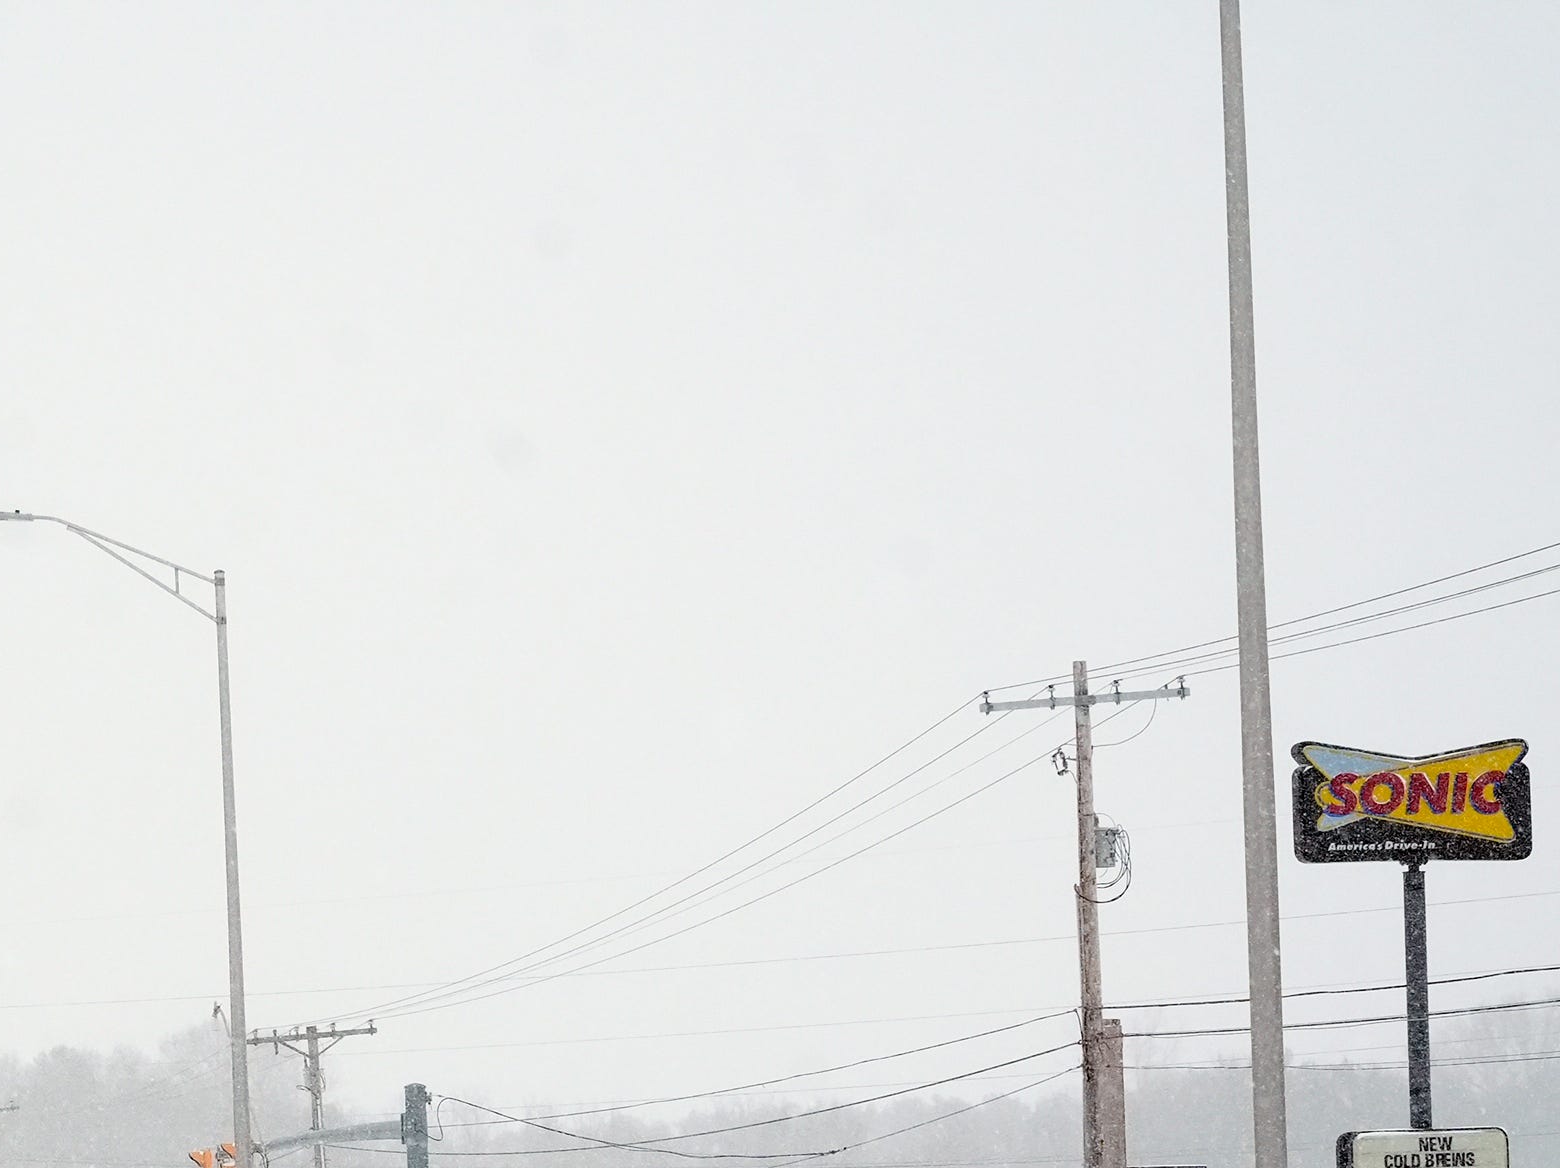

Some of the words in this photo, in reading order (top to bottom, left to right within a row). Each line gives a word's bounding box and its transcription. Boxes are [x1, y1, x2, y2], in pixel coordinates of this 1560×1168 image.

[1323, 769, 1506, 818] SONIC
[1327, 841, 1383, 852] America's
[1384, 840, 1436, 851] Drive-In
[1418, 1136, 1453, 1152] NEW
[1384, 1153, 1421, 1168] COLD
